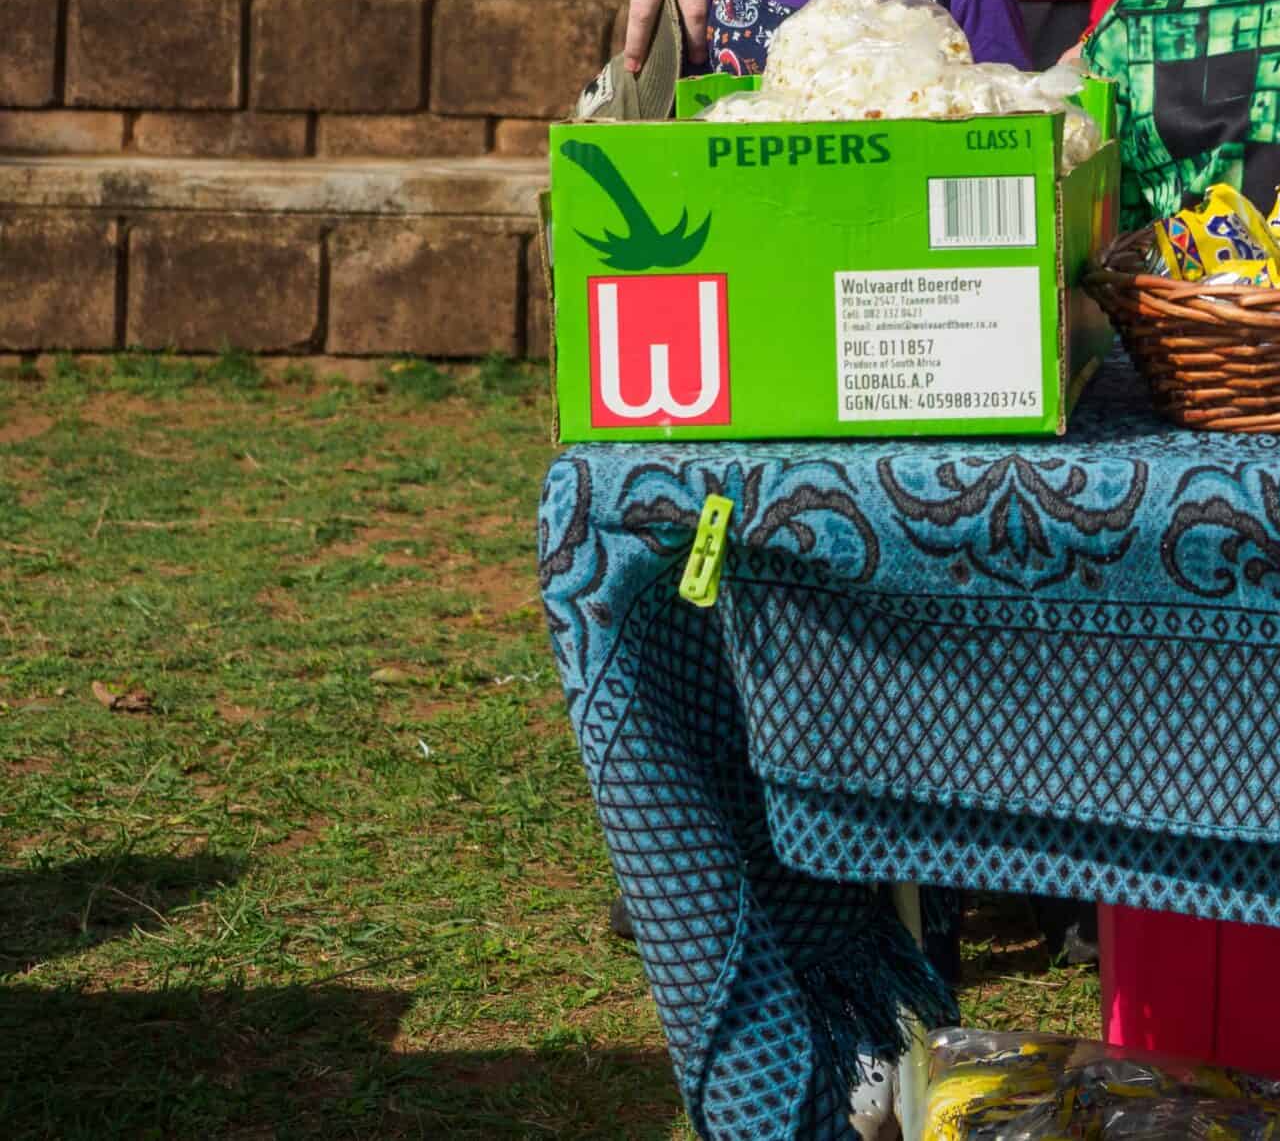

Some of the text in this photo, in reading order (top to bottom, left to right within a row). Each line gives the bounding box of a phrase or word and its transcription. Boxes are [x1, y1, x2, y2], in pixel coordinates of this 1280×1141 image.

[967, 130, 1031, 150] CLASS 1
[708, 133, 891, 168] PEPPERS
[841, 276, 982, 295] Wolvaardt Boerdery
[844, 341, 875, 356] PUC:
[880, 359, 889, 368] of
[891, 359, 915, 368] South
[917, 358, 941, 368] Africa
[845, 372, 934, 390] GLOBALG.A.P
[845, 393, 913, 411] GGN/GLN:
